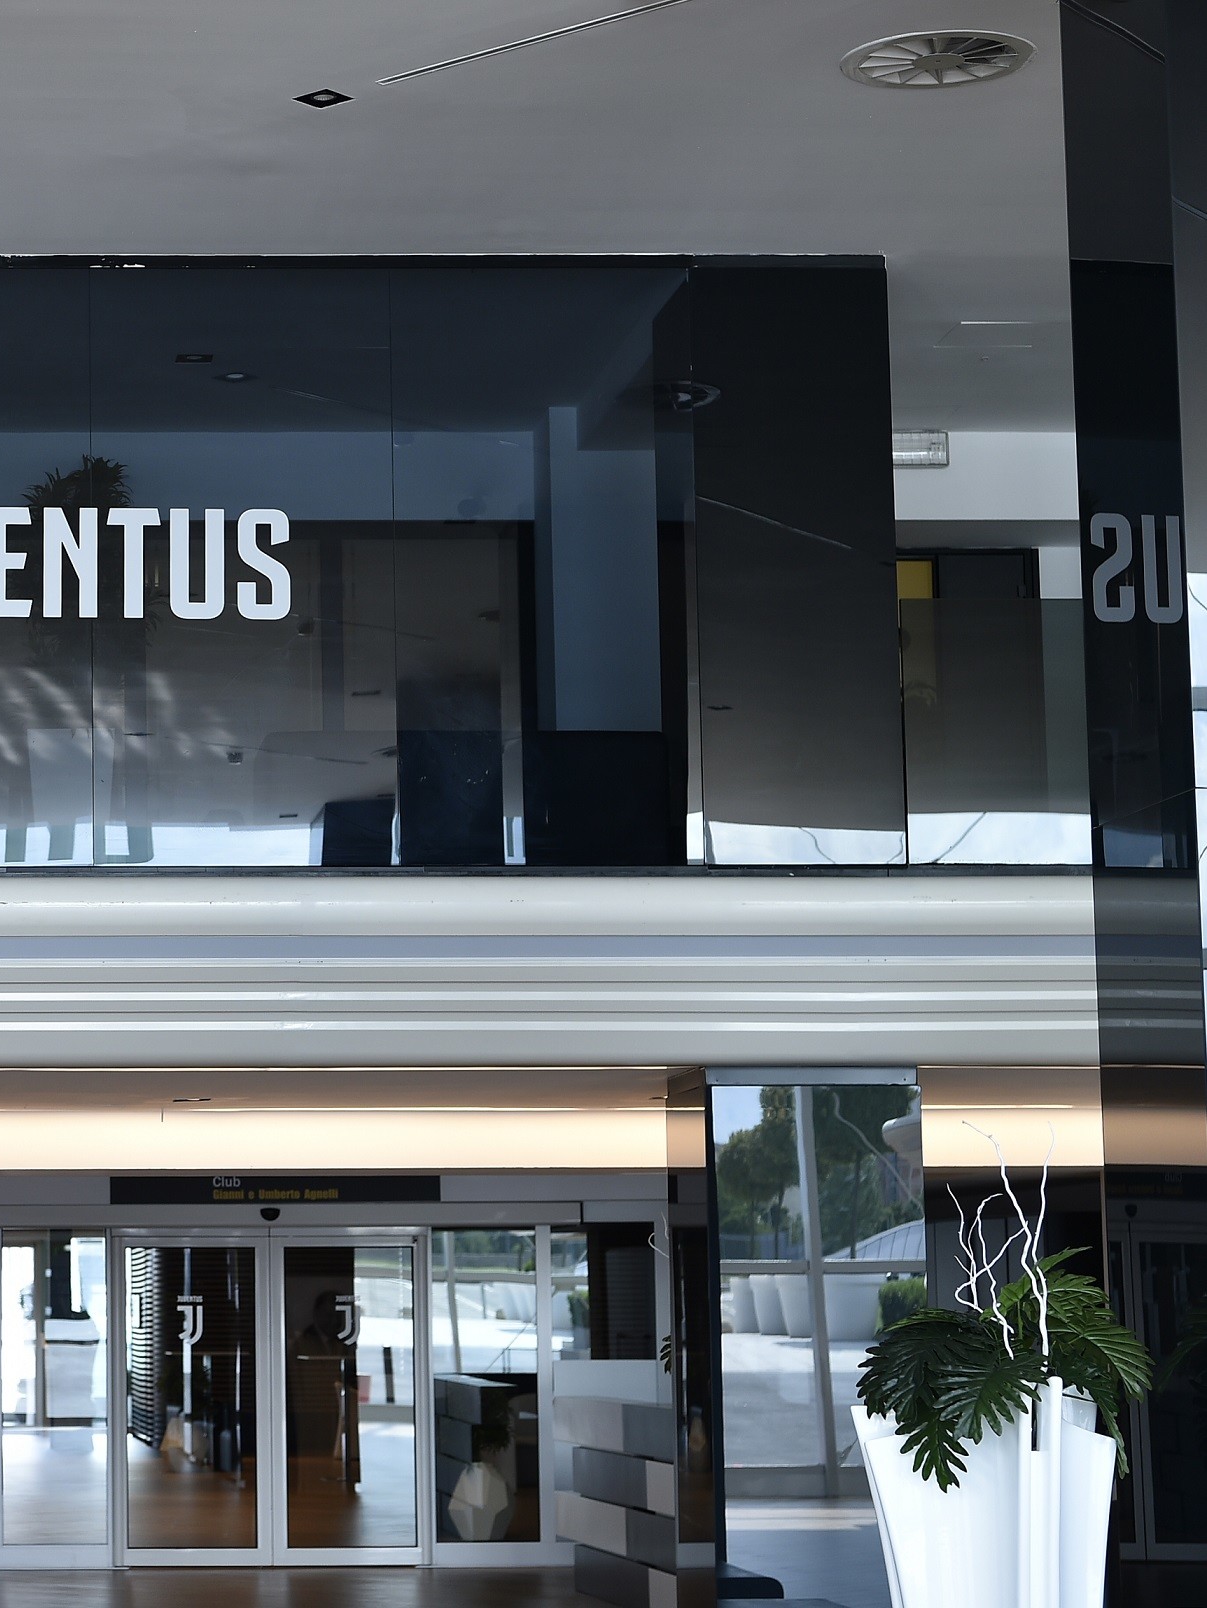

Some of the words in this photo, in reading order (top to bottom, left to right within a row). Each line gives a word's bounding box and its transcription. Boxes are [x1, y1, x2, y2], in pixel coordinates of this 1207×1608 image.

[212, 1176, 241, 1188] Club
[213, 1189, 245, 1200] Gianni
[248, 1191, 255, 1200] e
[258, 1189, 301, 1200] Umberto
[304, 1188, 339, 1201] Agnelli
